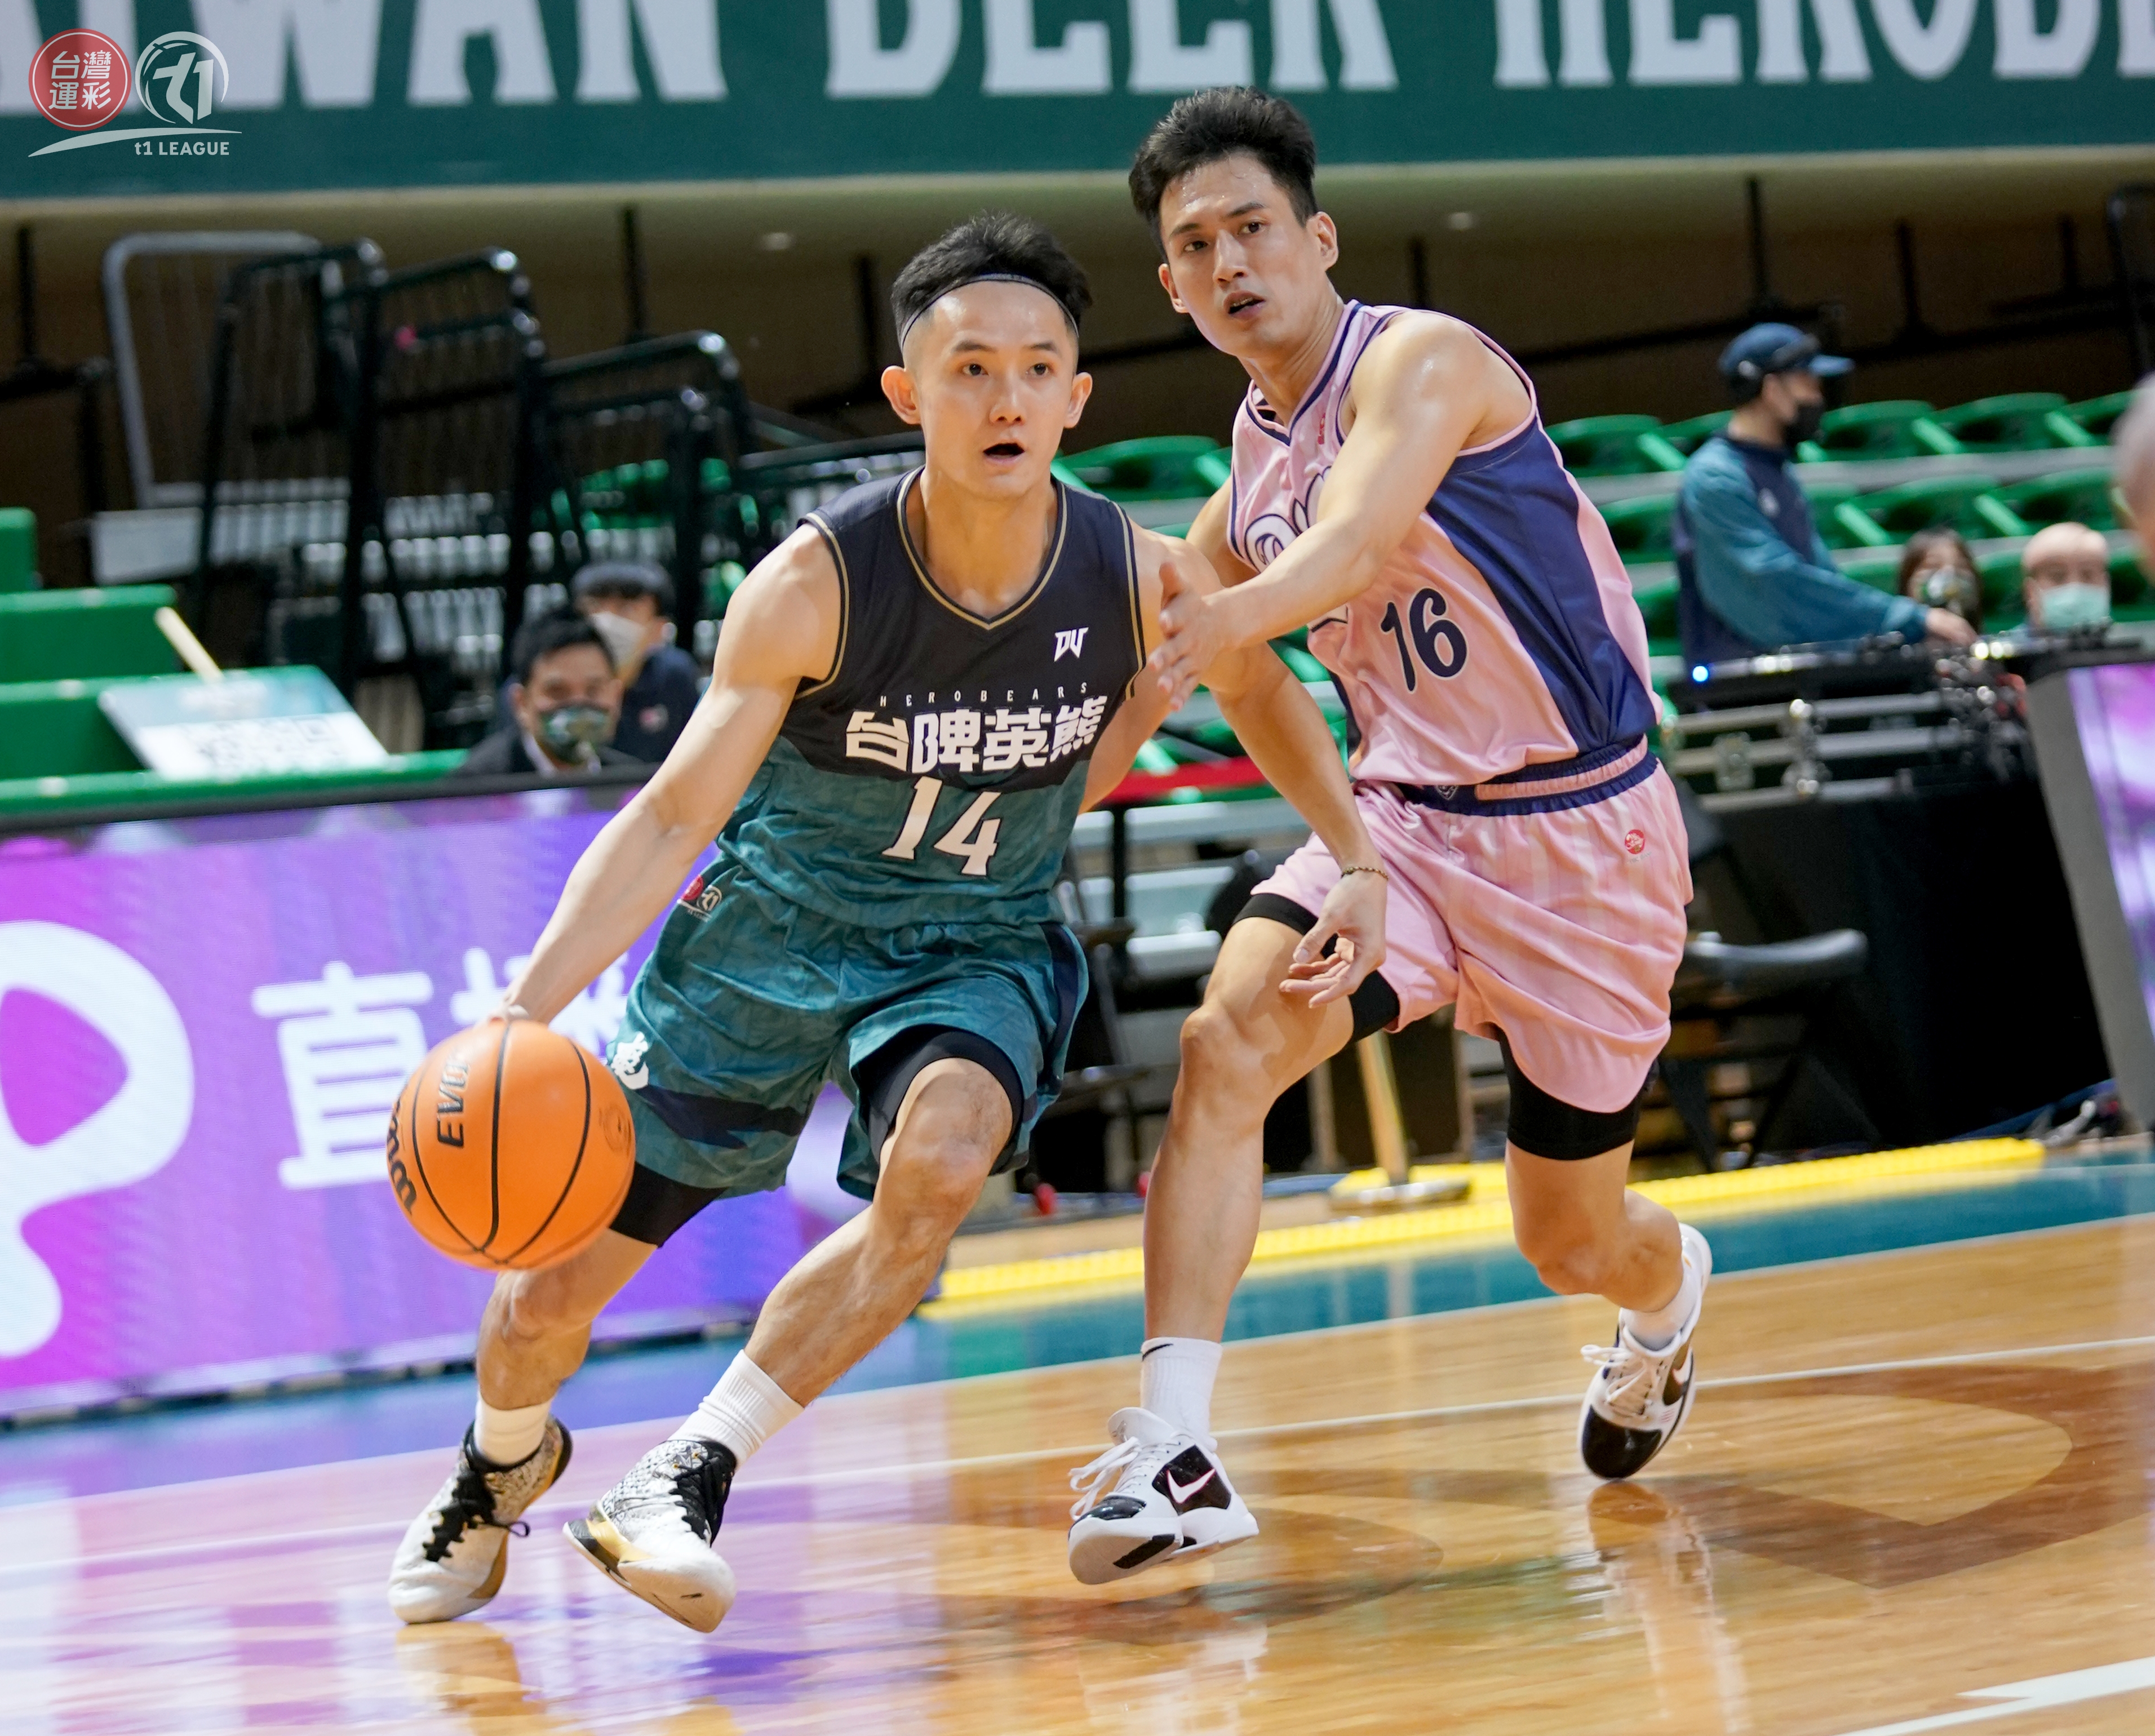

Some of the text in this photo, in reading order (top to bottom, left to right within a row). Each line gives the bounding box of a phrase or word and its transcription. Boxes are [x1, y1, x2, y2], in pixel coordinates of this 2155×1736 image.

[1380, 587, 1469, 693] 16
[879, 682, 1088, 708] HEROBEARS
[881, 775, 1003, 876] 14
